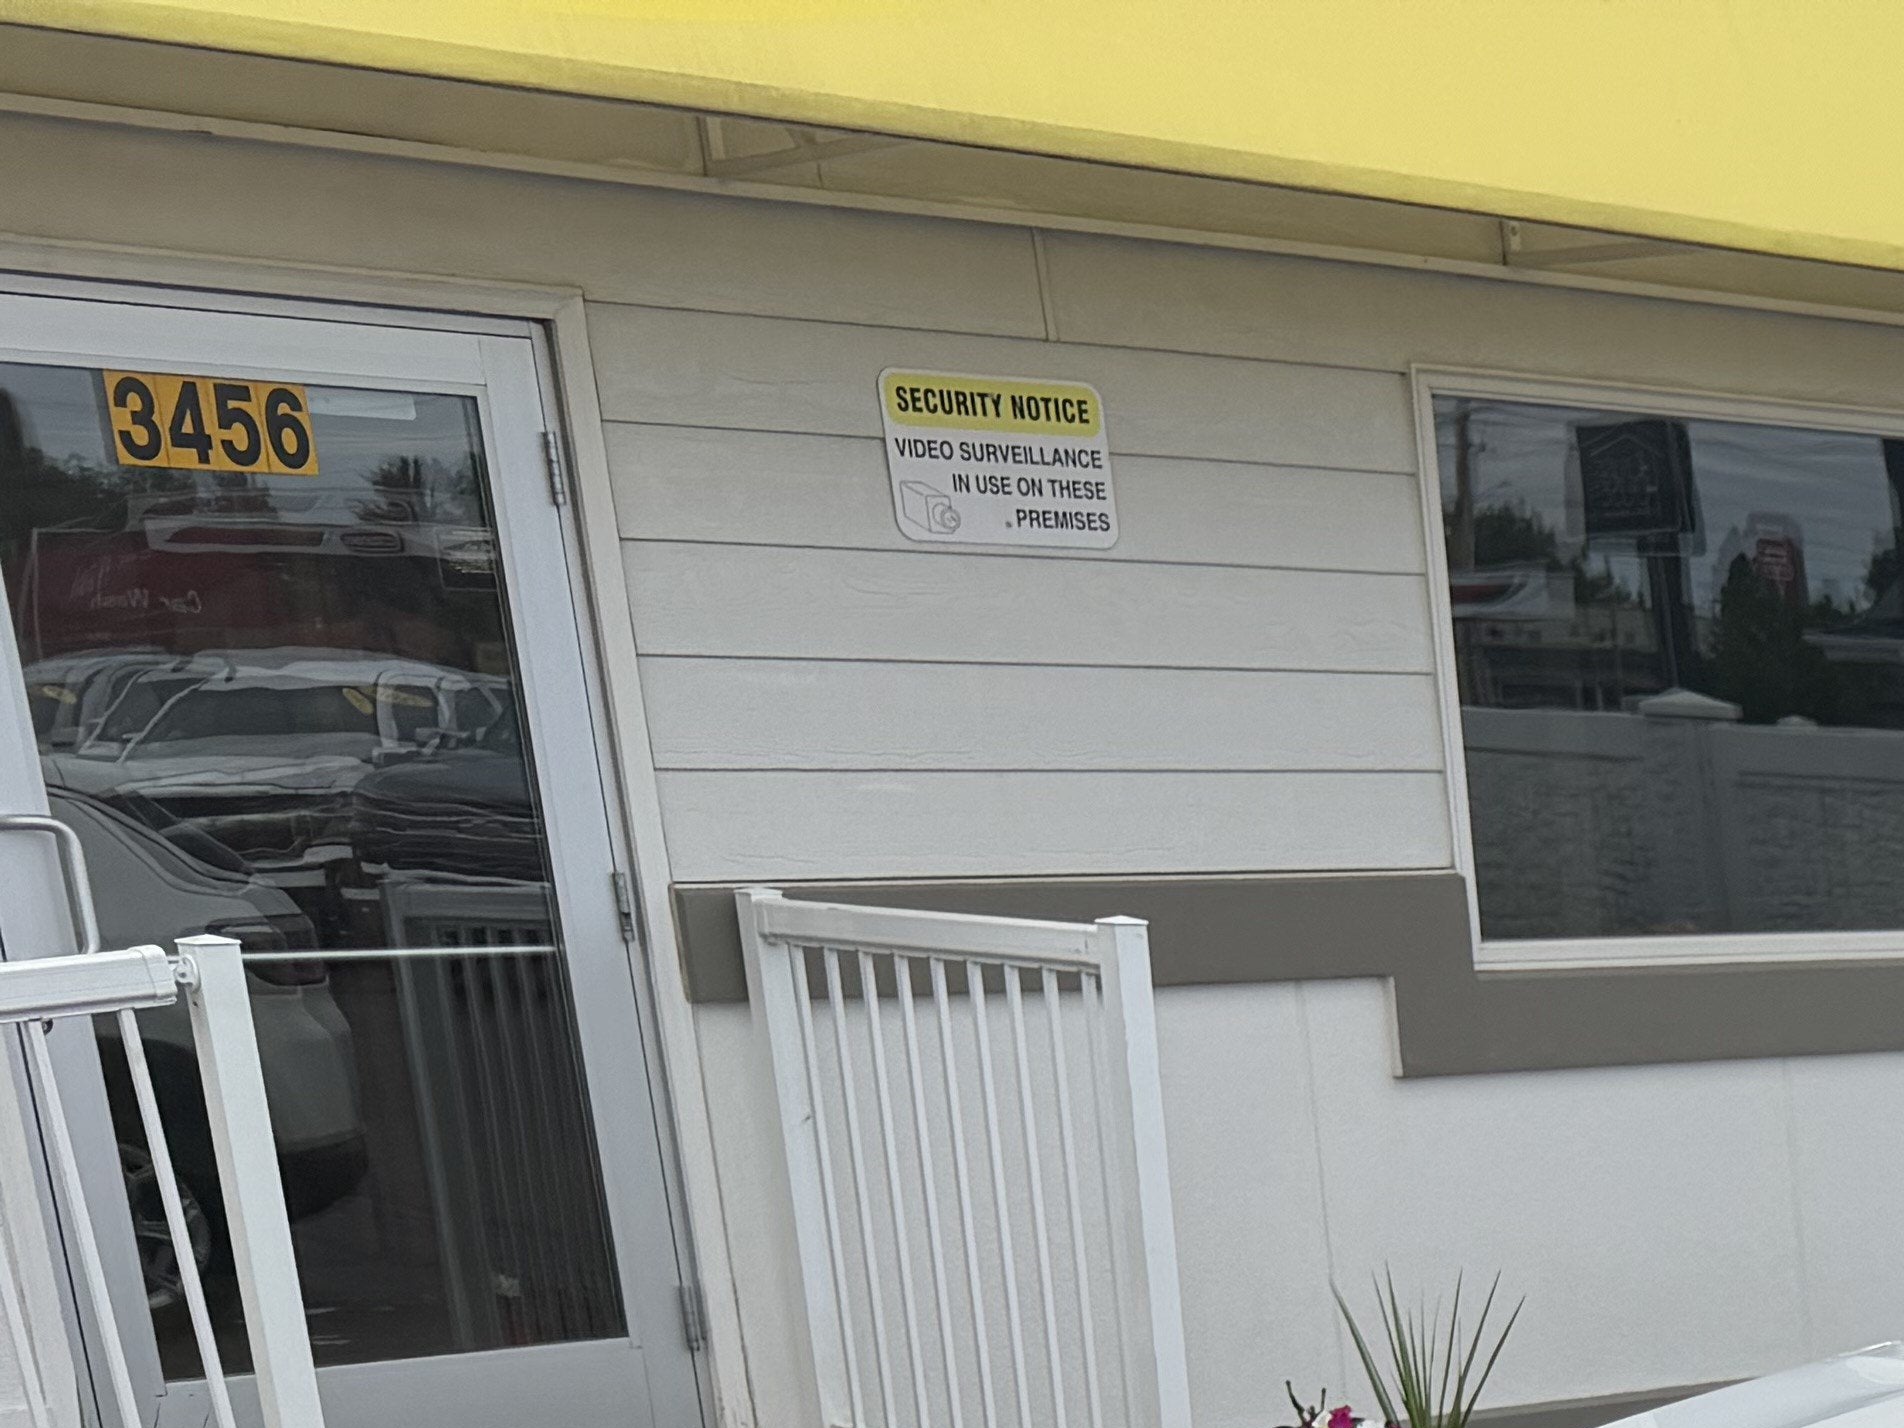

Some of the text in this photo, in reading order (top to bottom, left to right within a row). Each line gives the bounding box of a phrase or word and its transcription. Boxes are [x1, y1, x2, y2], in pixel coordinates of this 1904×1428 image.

[895, 385, 1091, 424] SECURITY NOTICE
[112, 375, 311, 470] 3456
[895, 437, 1103, 470] VIDEO SURVEILLANCE
[952, 473, 1108, 501] IN USE ON THESE
[1015, 508, 1111, 532] PREMISES
